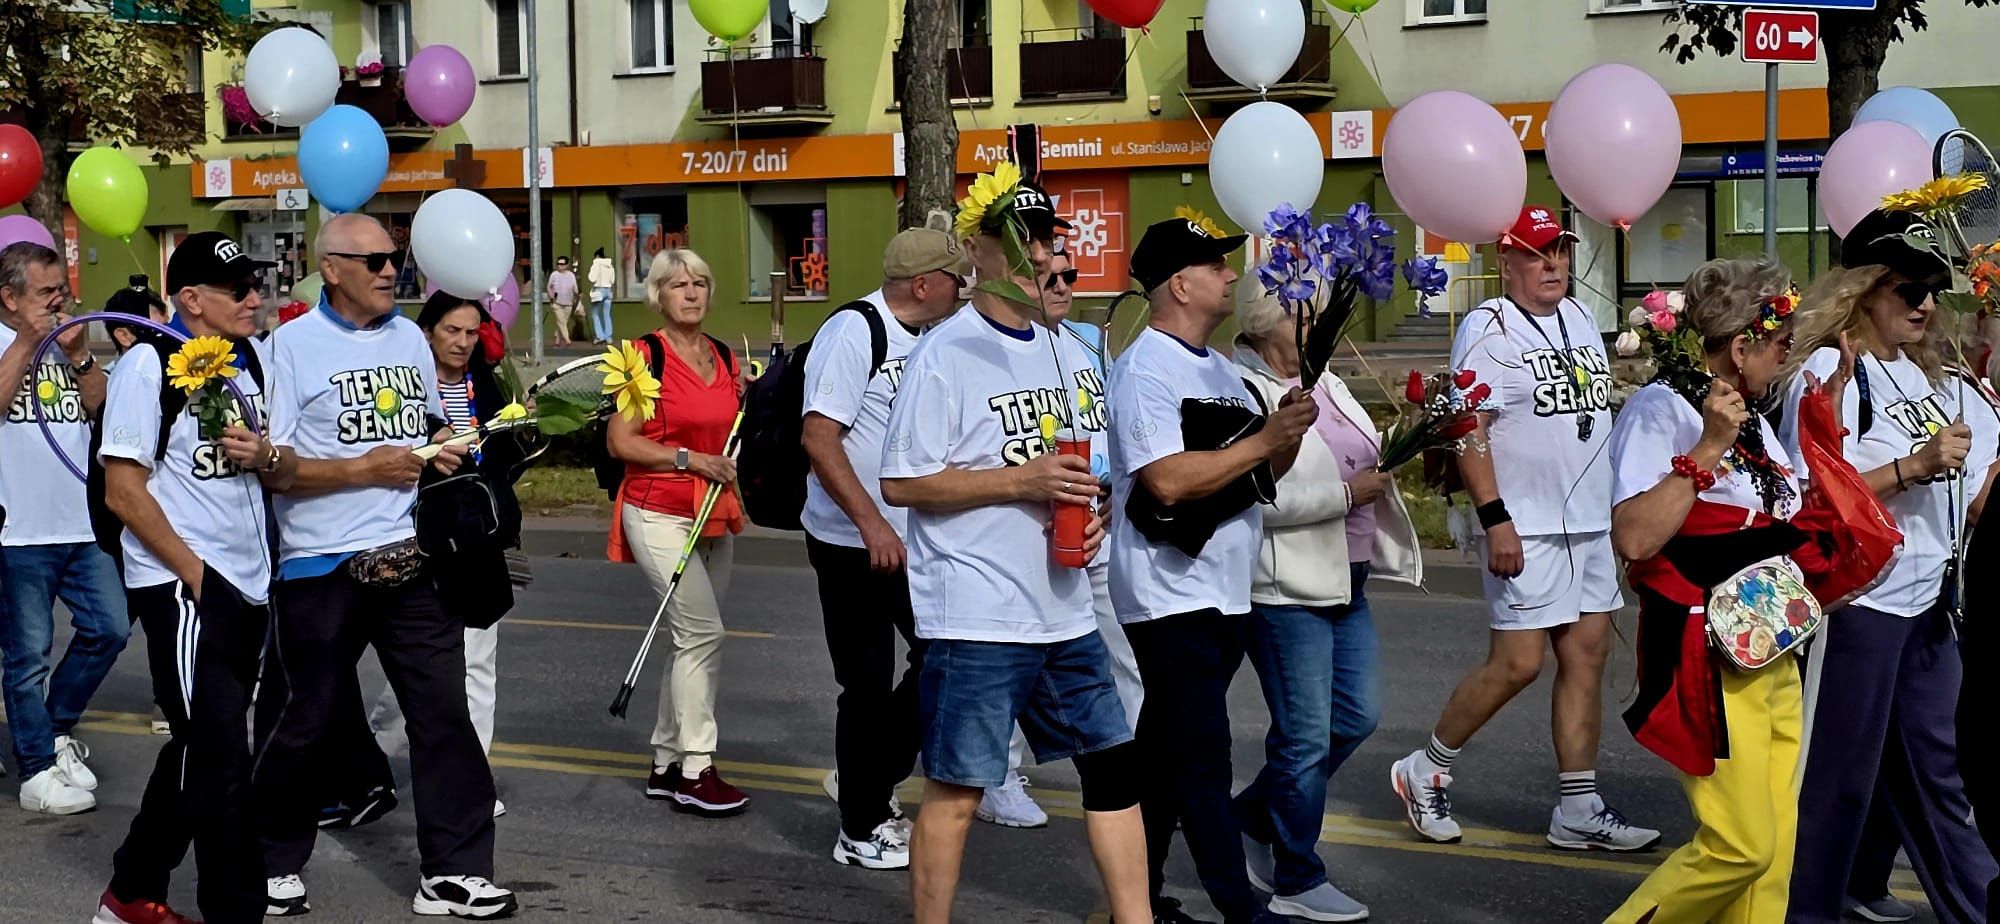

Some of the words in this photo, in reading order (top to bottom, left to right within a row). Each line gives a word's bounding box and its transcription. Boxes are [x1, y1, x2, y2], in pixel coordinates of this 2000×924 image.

[1755, 21, 1781, 51] 60
[682, 150, 747, 175] 7-20/7
[753, 148, 788, 172] dni
[1112, 142, 1125, 155] ul.
[1127, 140, 1188, 156] Stanisława
[253, 170, 297, 190] Apteka
[620, 226, 637, 261] 7
[329, 366, 428, 407] TENNIS
